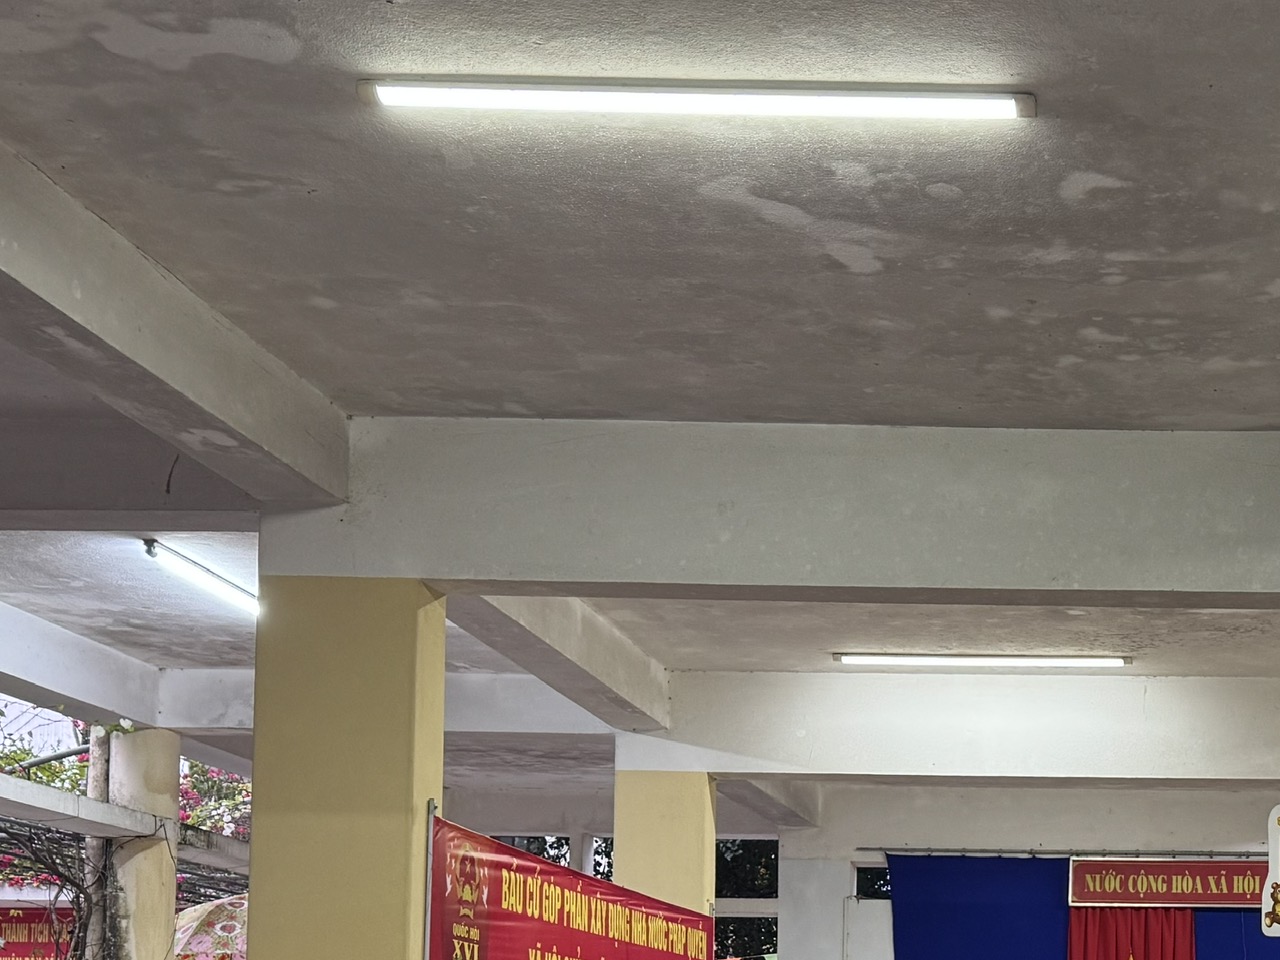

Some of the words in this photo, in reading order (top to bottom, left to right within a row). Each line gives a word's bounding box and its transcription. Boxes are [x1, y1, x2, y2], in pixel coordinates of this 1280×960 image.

[502, 858, 523, 914] BẦU
[526, 865, 541, 919] CỬ
[543, 876, 561, 924] GÓP
[590, 892, 606, 936] XÂY
[1084, 869, 1124, 893] NƯỚC
[1128, 870, 1167, 898] CỘNG
[1171, 870, 1203, 893] HÒA
[1207, 870, 1228, 893] XÃ
[1233, 870, 1260, 898] HỘI
